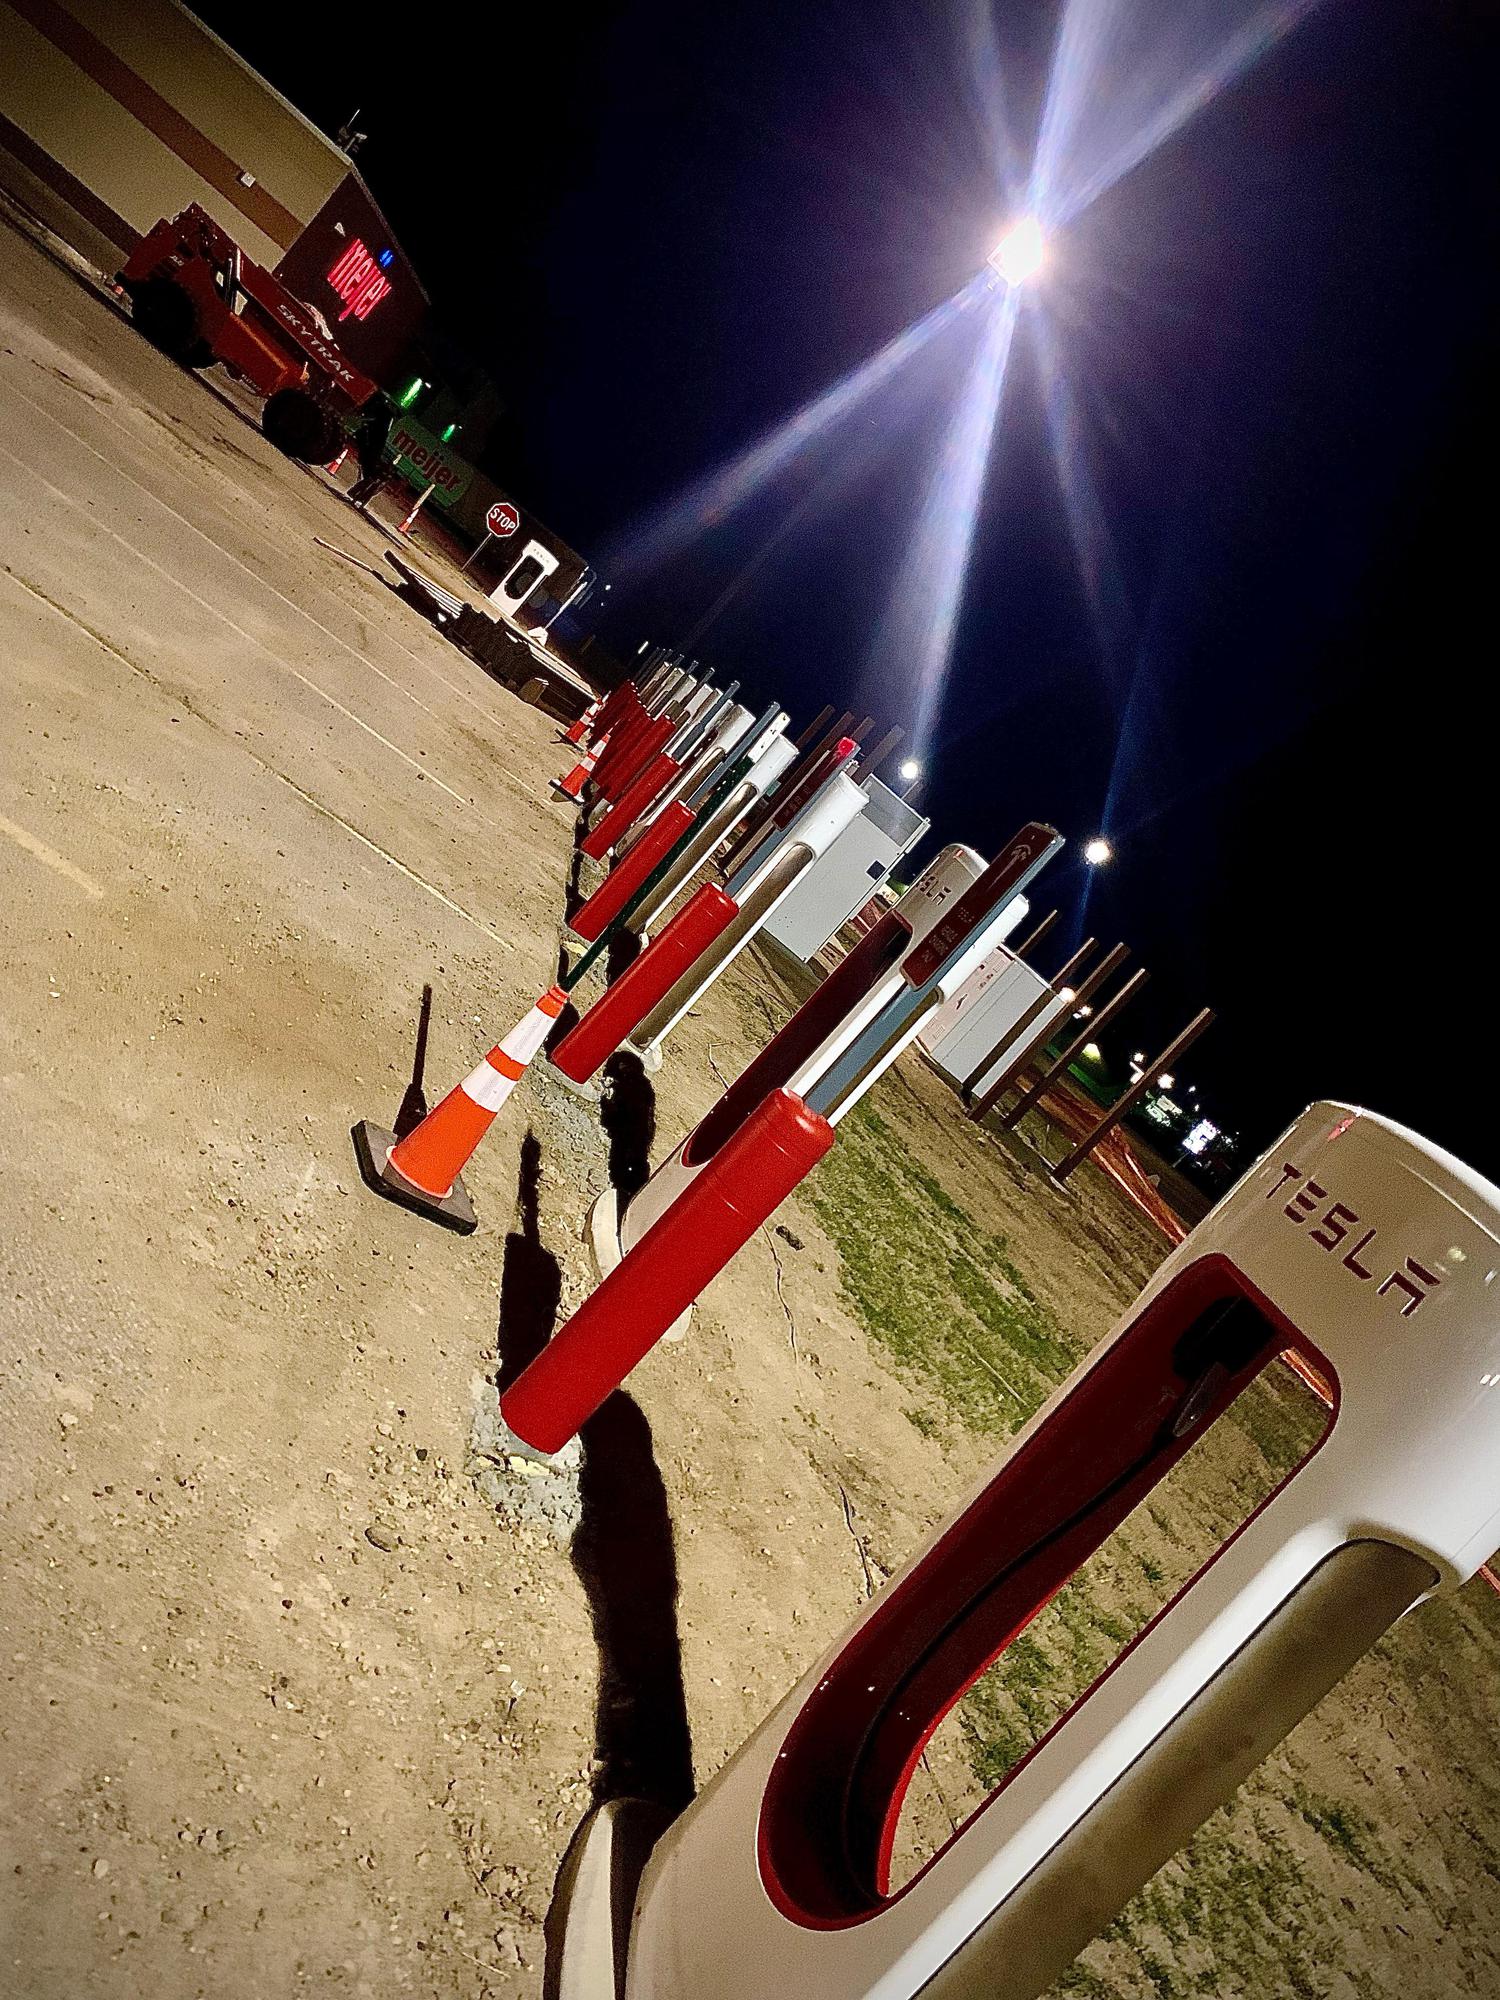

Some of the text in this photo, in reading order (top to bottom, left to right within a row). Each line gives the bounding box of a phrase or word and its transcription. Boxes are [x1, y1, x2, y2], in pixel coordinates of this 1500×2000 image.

[327, 238, 393, 321] meijer
[277, 304, 355, 382] SKYTRAK
[392, 429, 462, 491] meijer
[489, 506, 516, 532] STOP
[1265, 1162, 1441, 1318] TESLA
